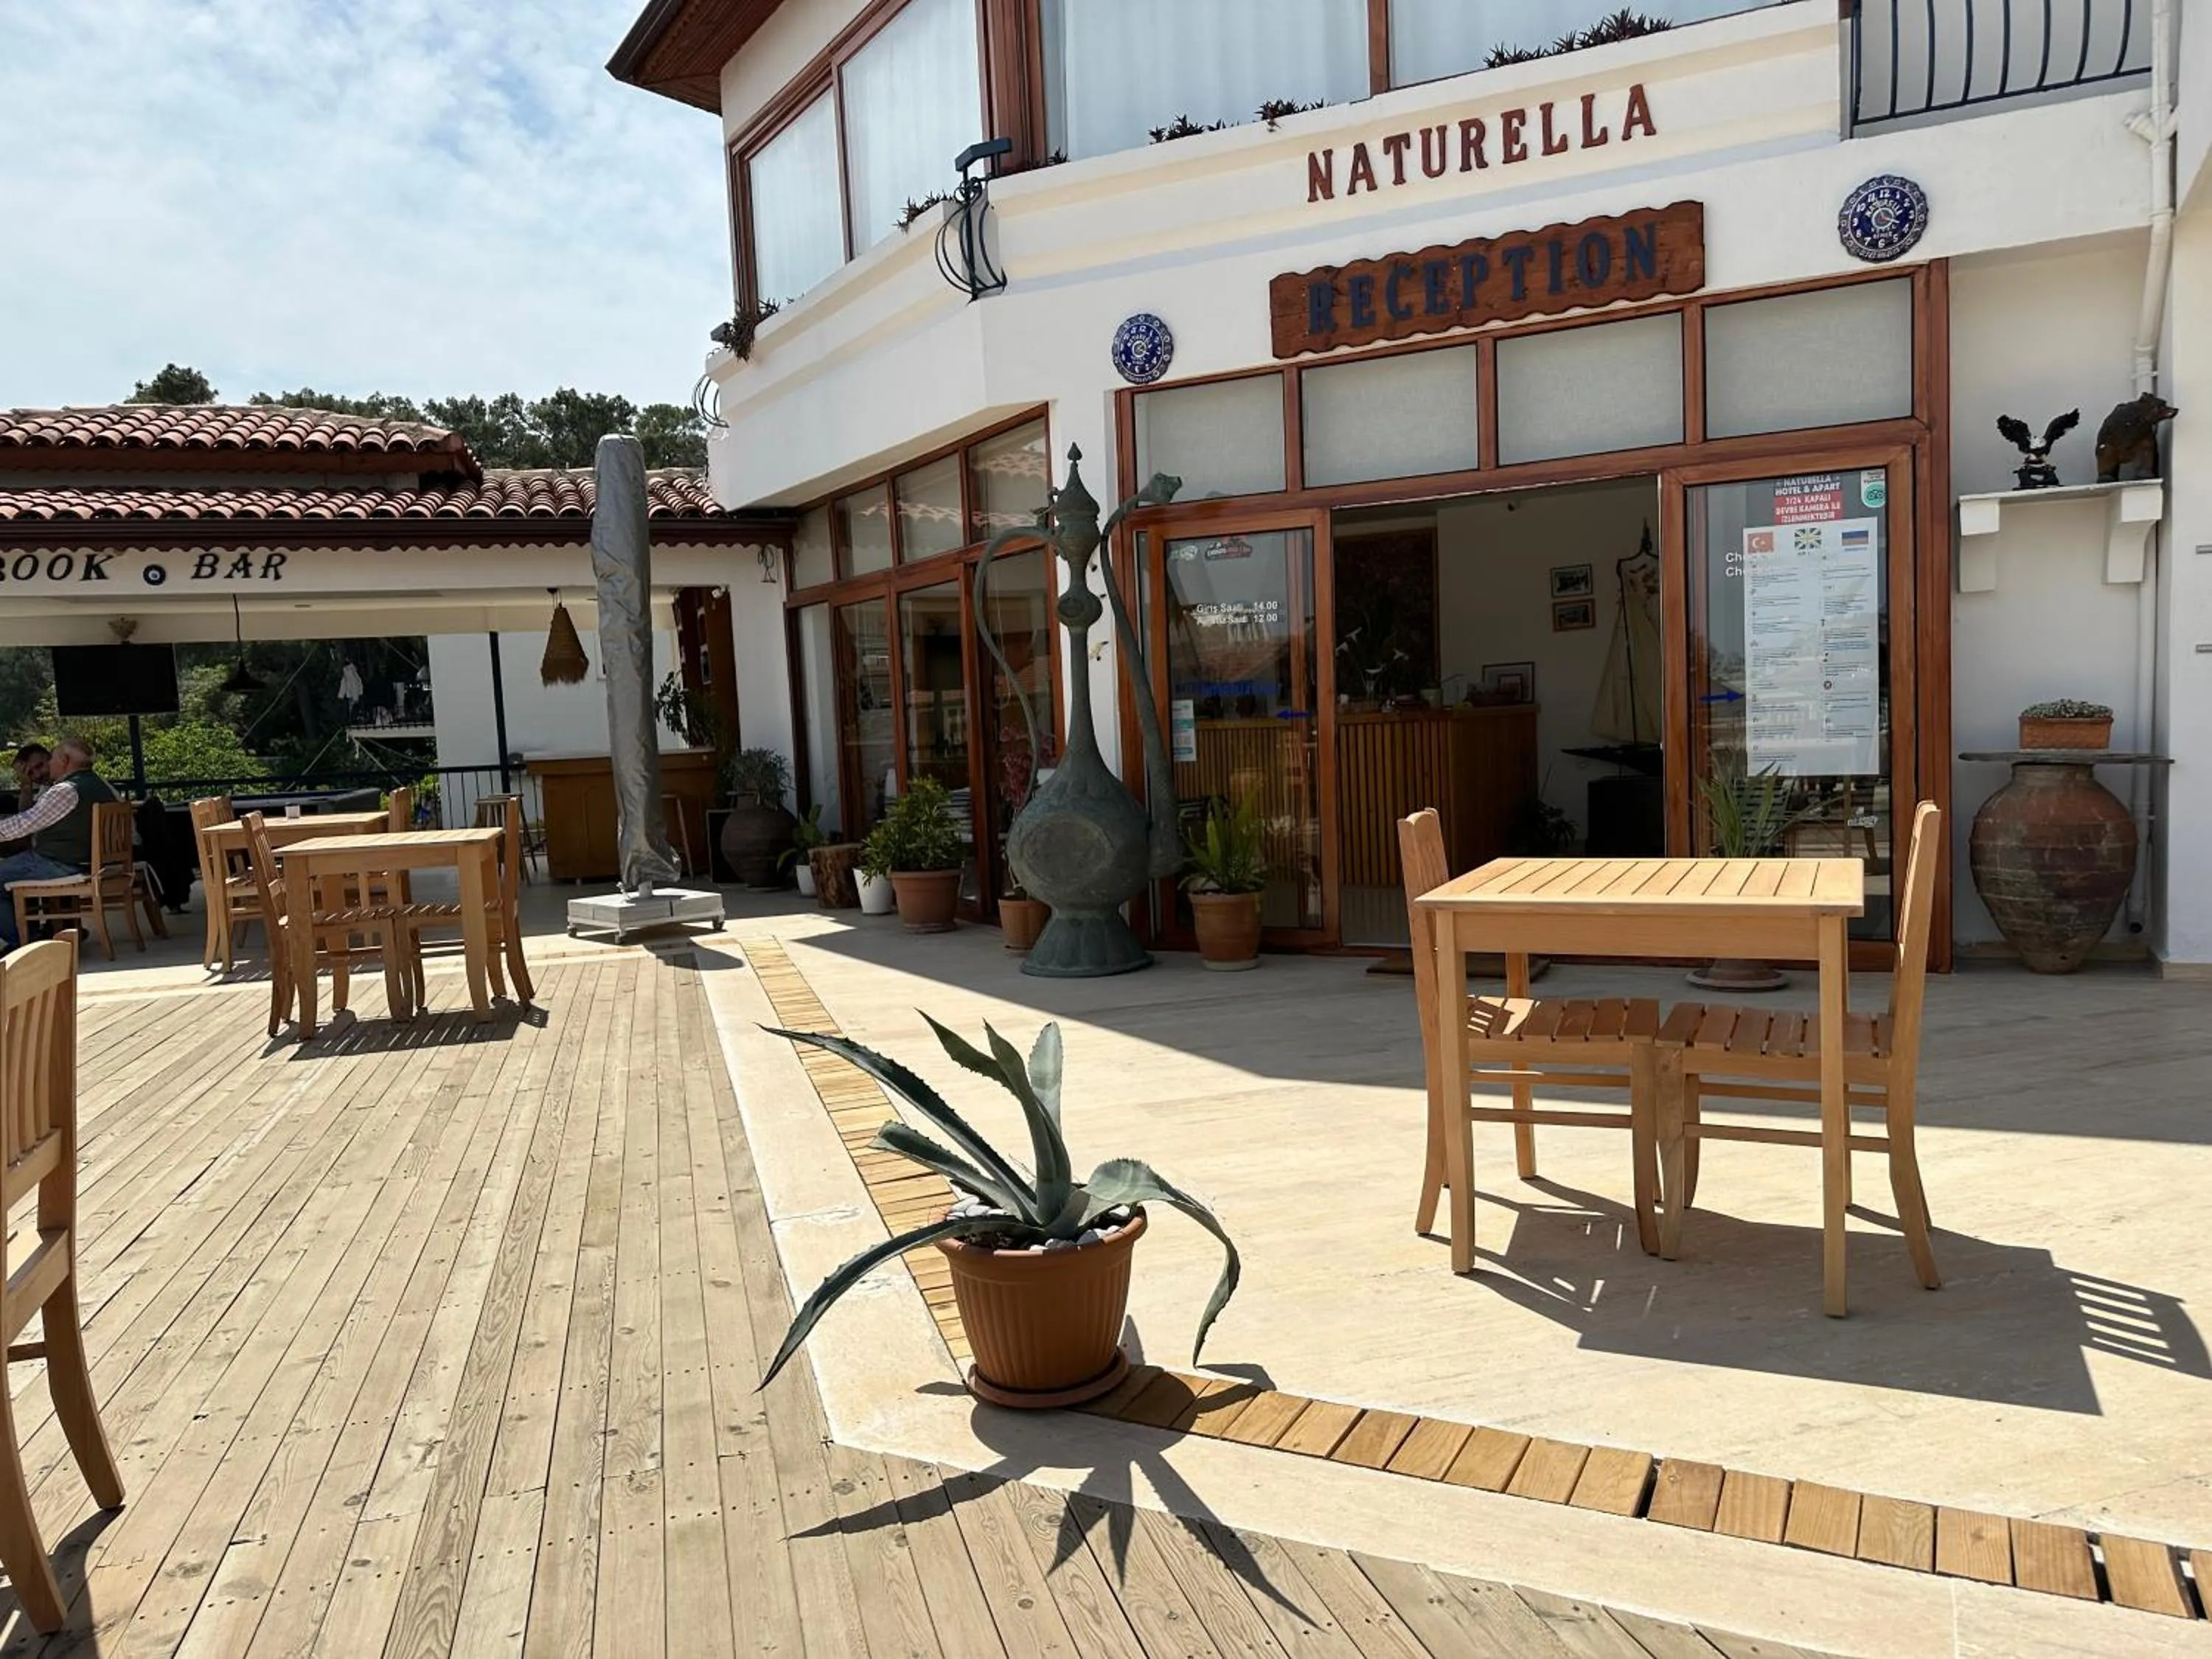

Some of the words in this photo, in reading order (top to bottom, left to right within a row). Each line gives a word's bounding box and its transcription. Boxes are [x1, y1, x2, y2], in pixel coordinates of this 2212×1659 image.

[1307, 83, 1657, 202] NATURELLA
[1308, 223, 1658, 335] RECEPTION
[1775, 487, 1801, 496] HOTEL
[1812, 481, 1841, 492] APART
[0, 553, 115, 582] OOK
[191, 552, 288, 581] BAR
